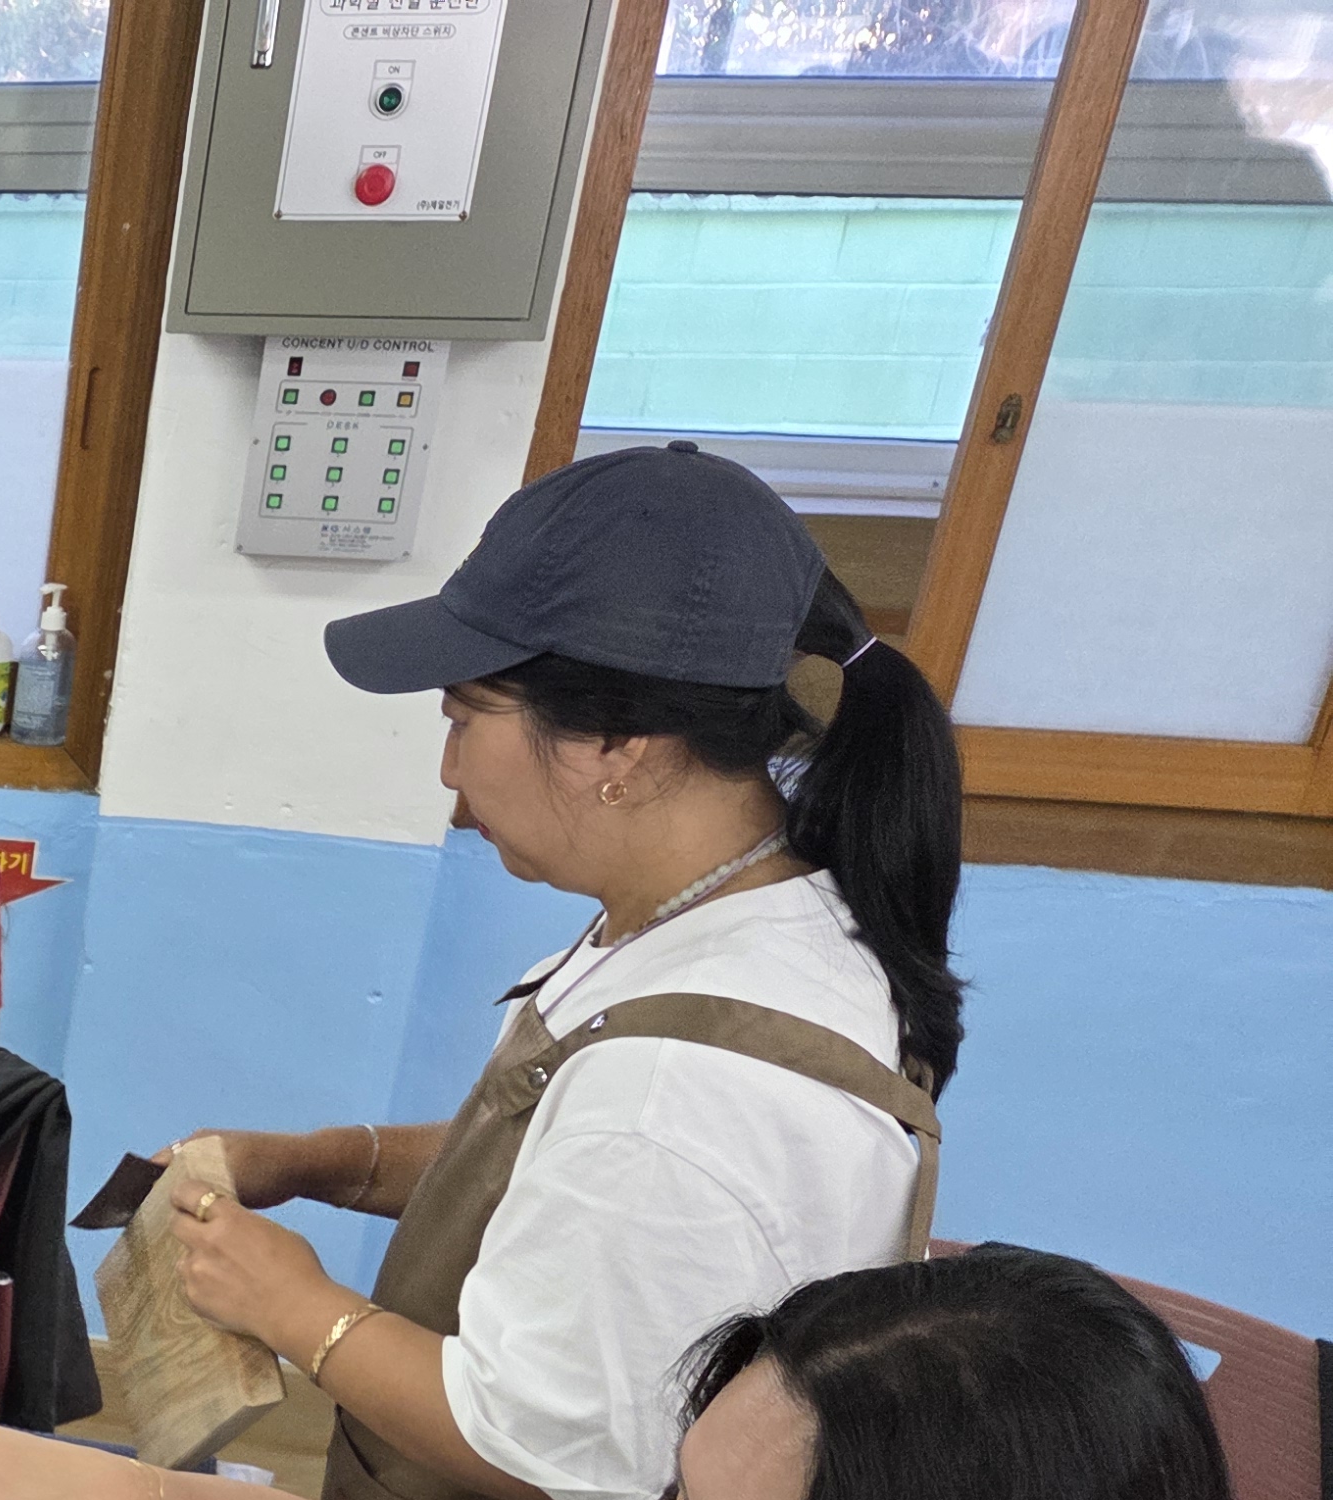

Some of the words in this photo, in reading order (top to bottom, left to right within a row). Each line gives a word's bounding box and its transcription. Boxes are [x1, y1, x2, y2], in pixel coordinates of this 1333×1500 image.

[388, 66, 400, 74] ON
[373, 151, 387, 159] OFF
[282, 337, 343, 349] CONCENT
[347, 339, 370, 350] U/D
[373, 340, 435, 353] CONTROL
